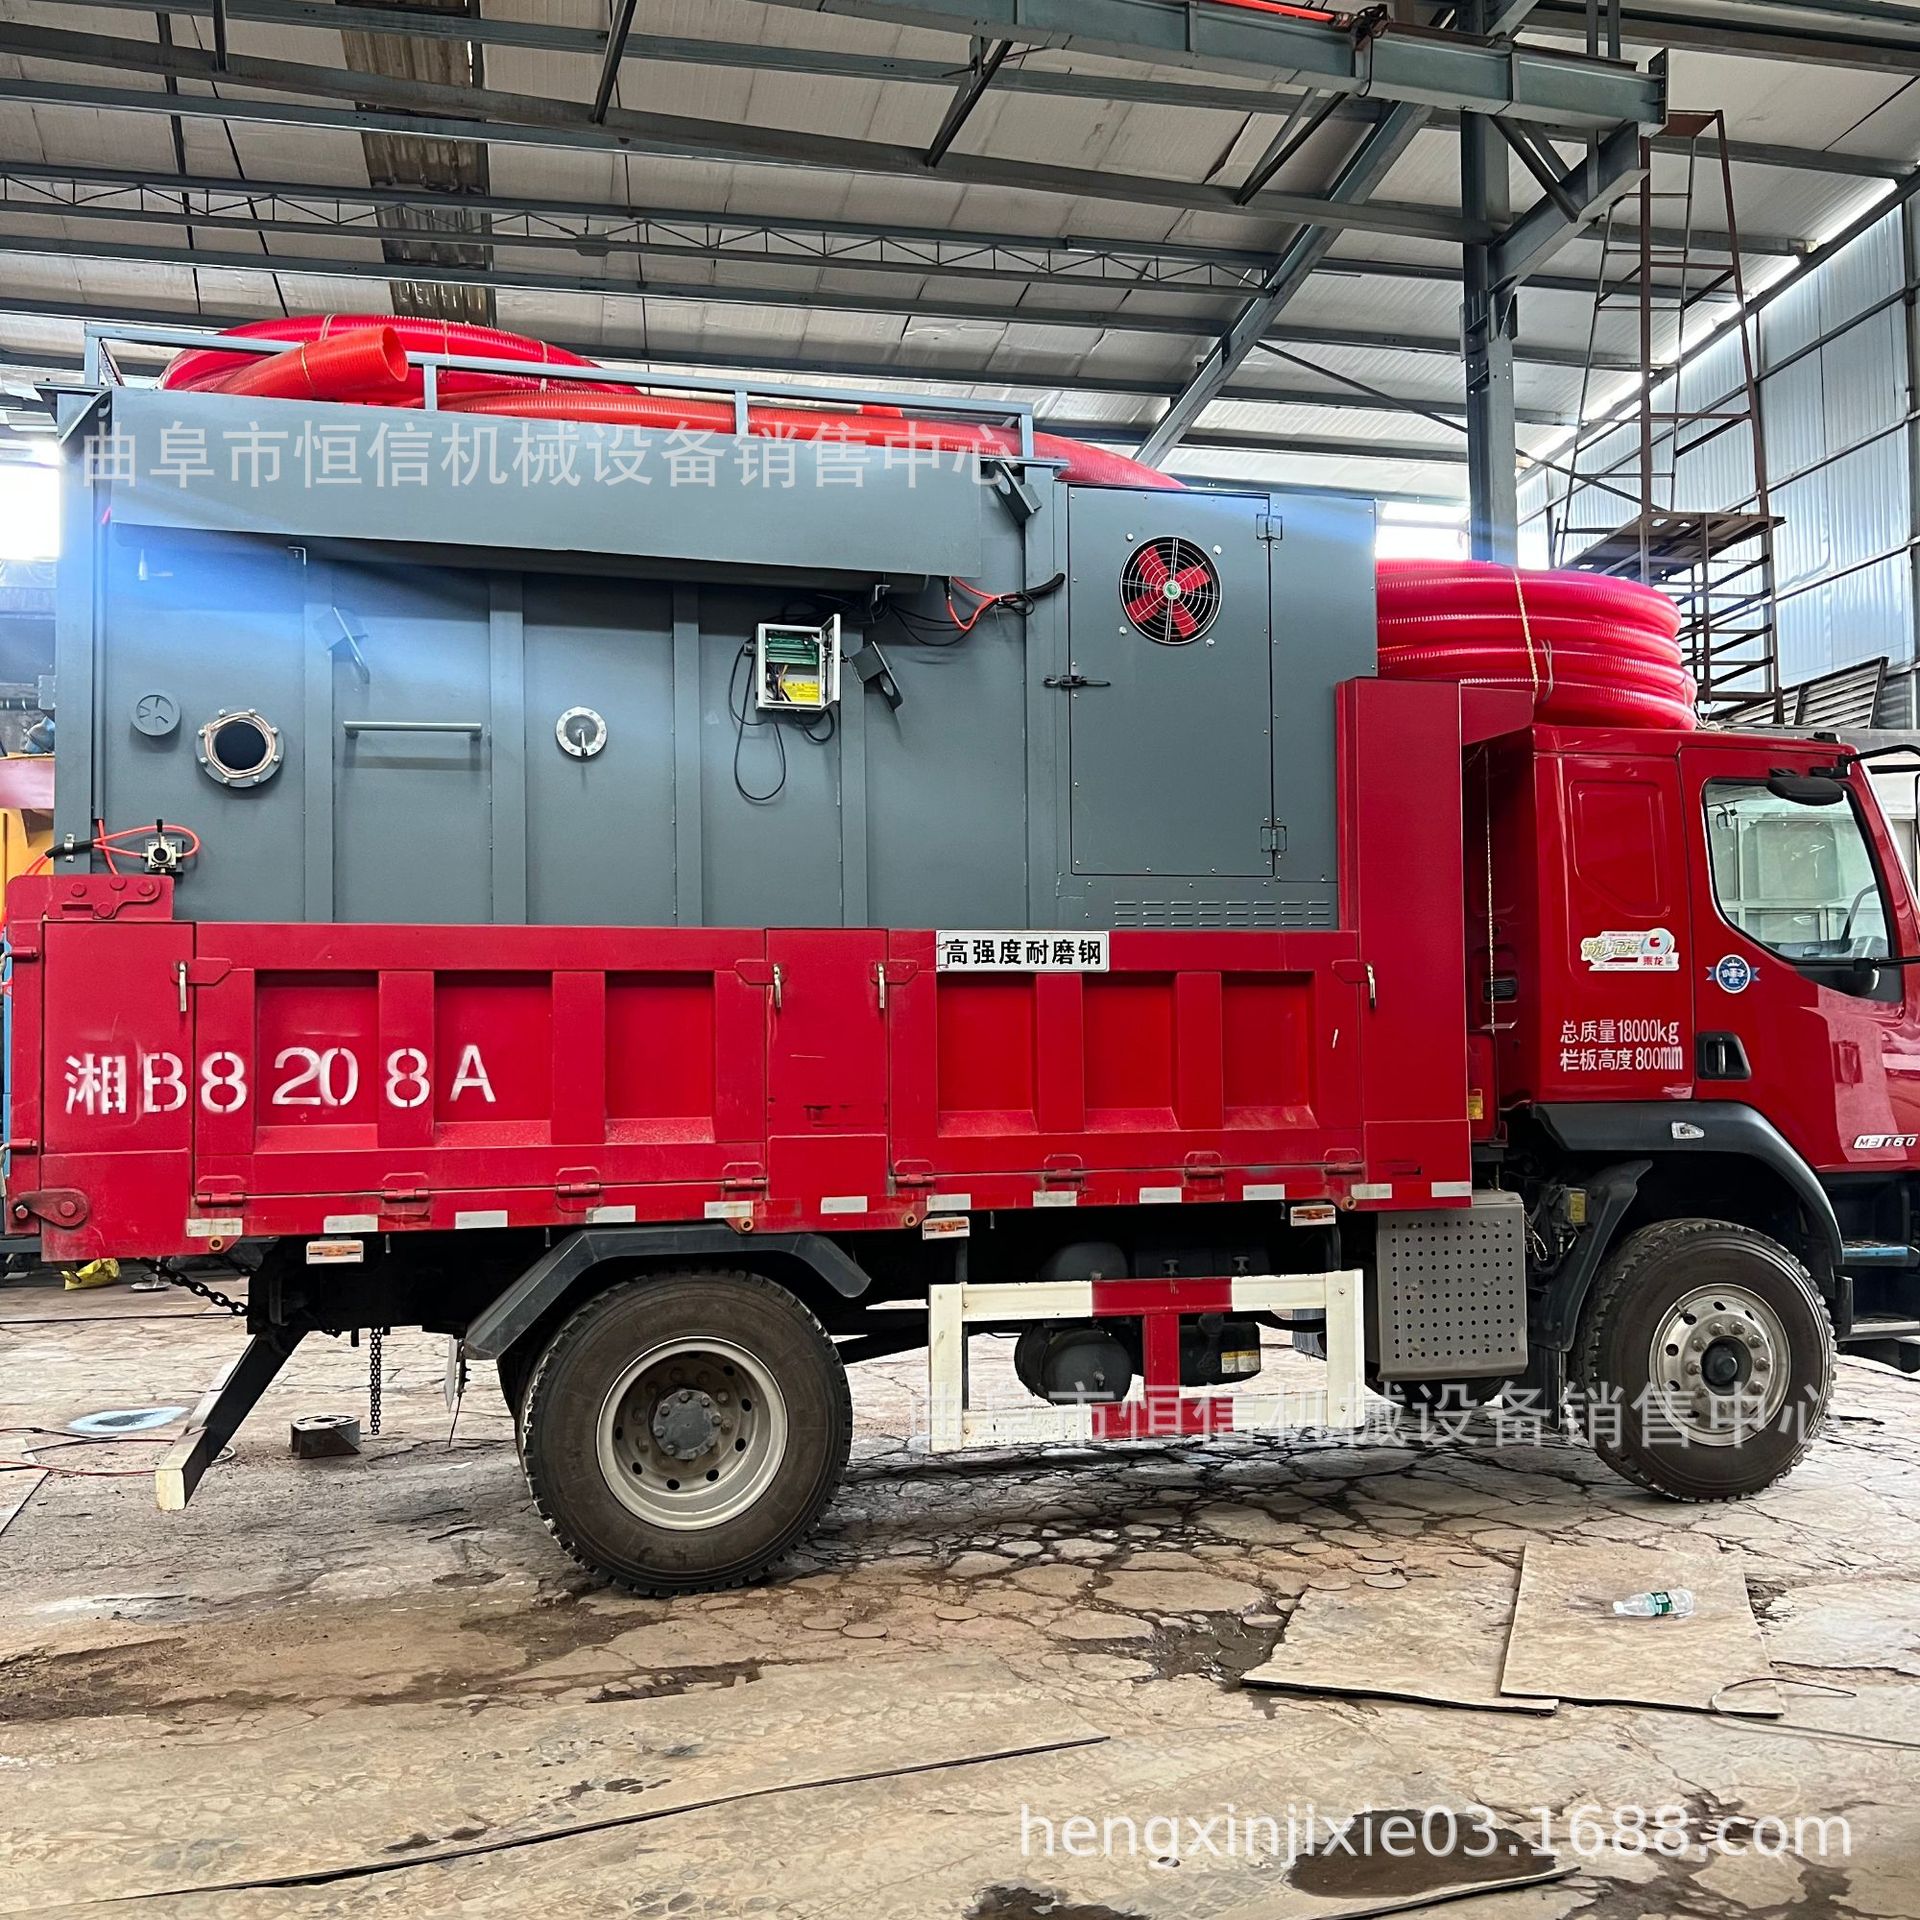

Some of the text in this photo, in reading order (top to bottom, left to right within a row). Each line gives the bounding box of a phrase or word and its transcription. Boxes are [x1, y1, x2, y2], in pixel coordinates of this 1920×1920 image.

[945, 938, 1102, 966] 高强度耐磨钢
